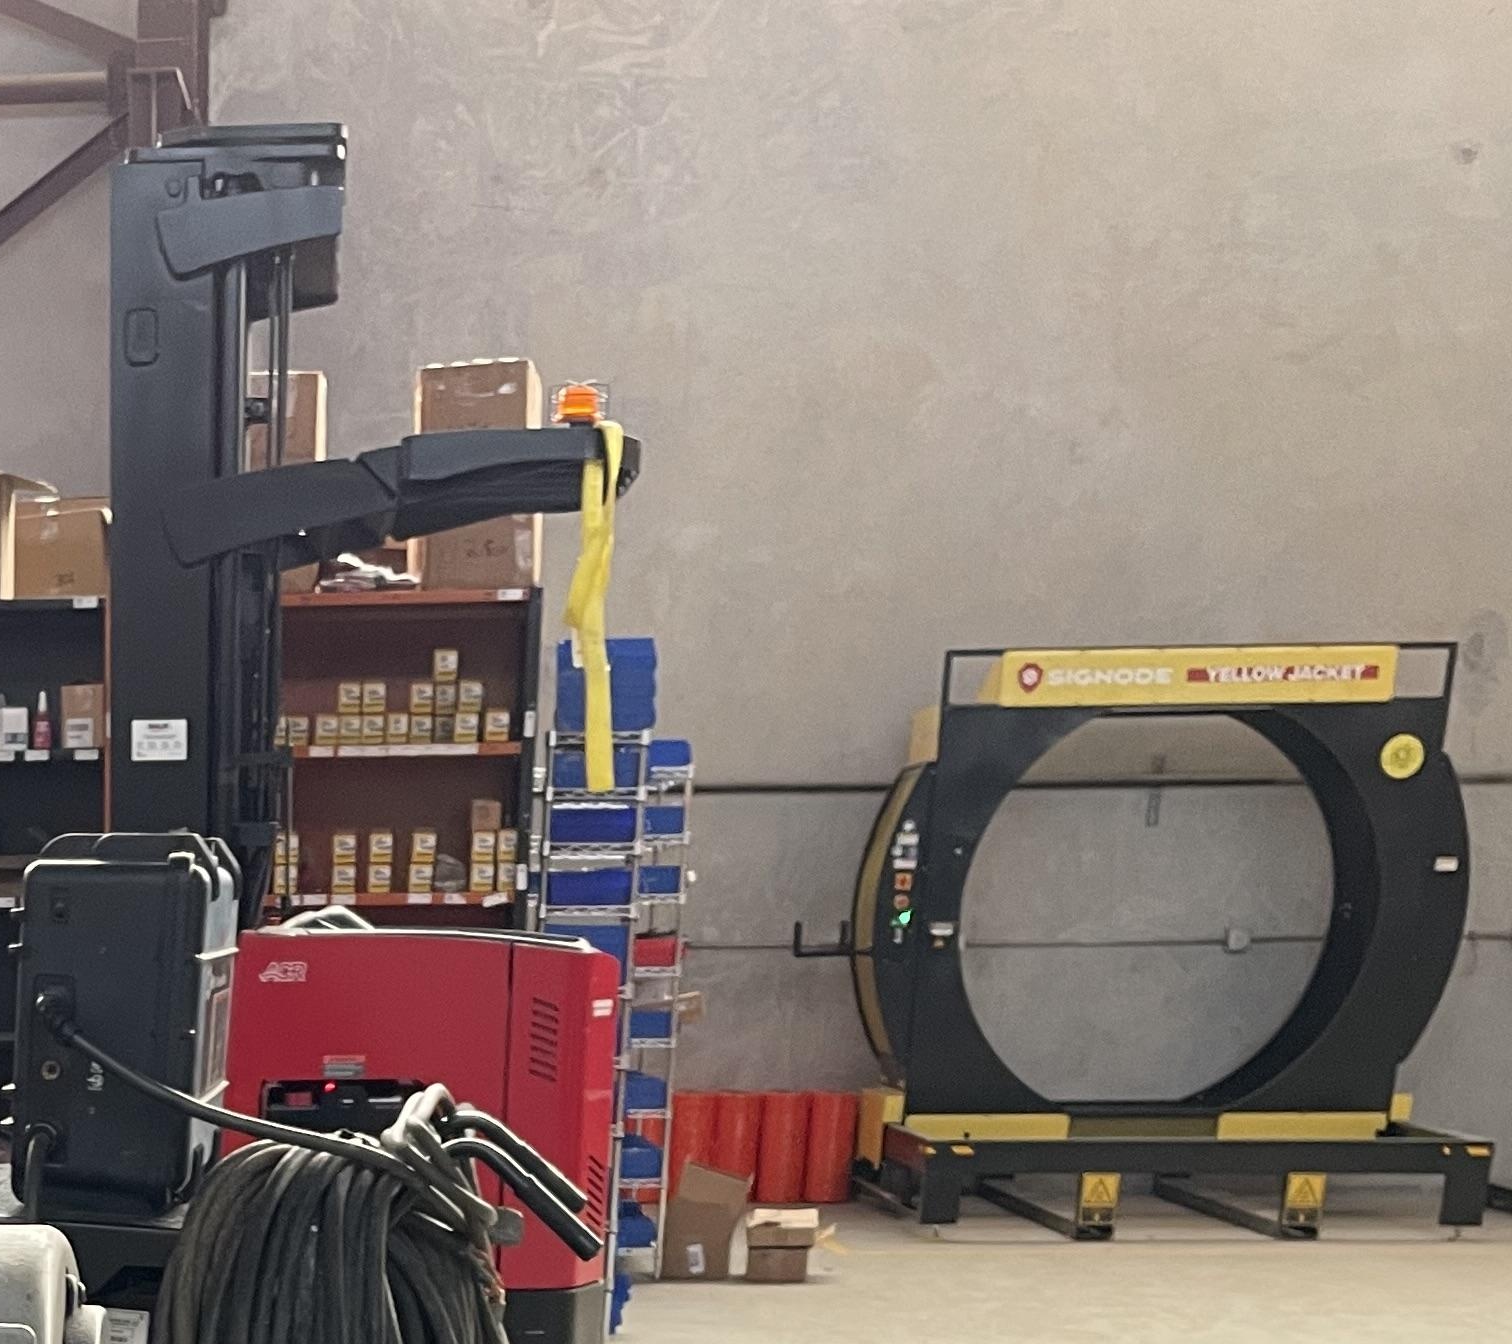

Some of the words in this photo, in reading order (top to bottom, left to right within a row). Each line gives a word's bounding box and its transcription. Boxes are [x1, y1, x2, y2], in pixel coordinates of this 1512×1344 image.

[1047, 666, 1172, 687] SIGNODE
[1206, 665, 1286, 684] YELLOW
[1287, 663, 1364, 682] JACKET
